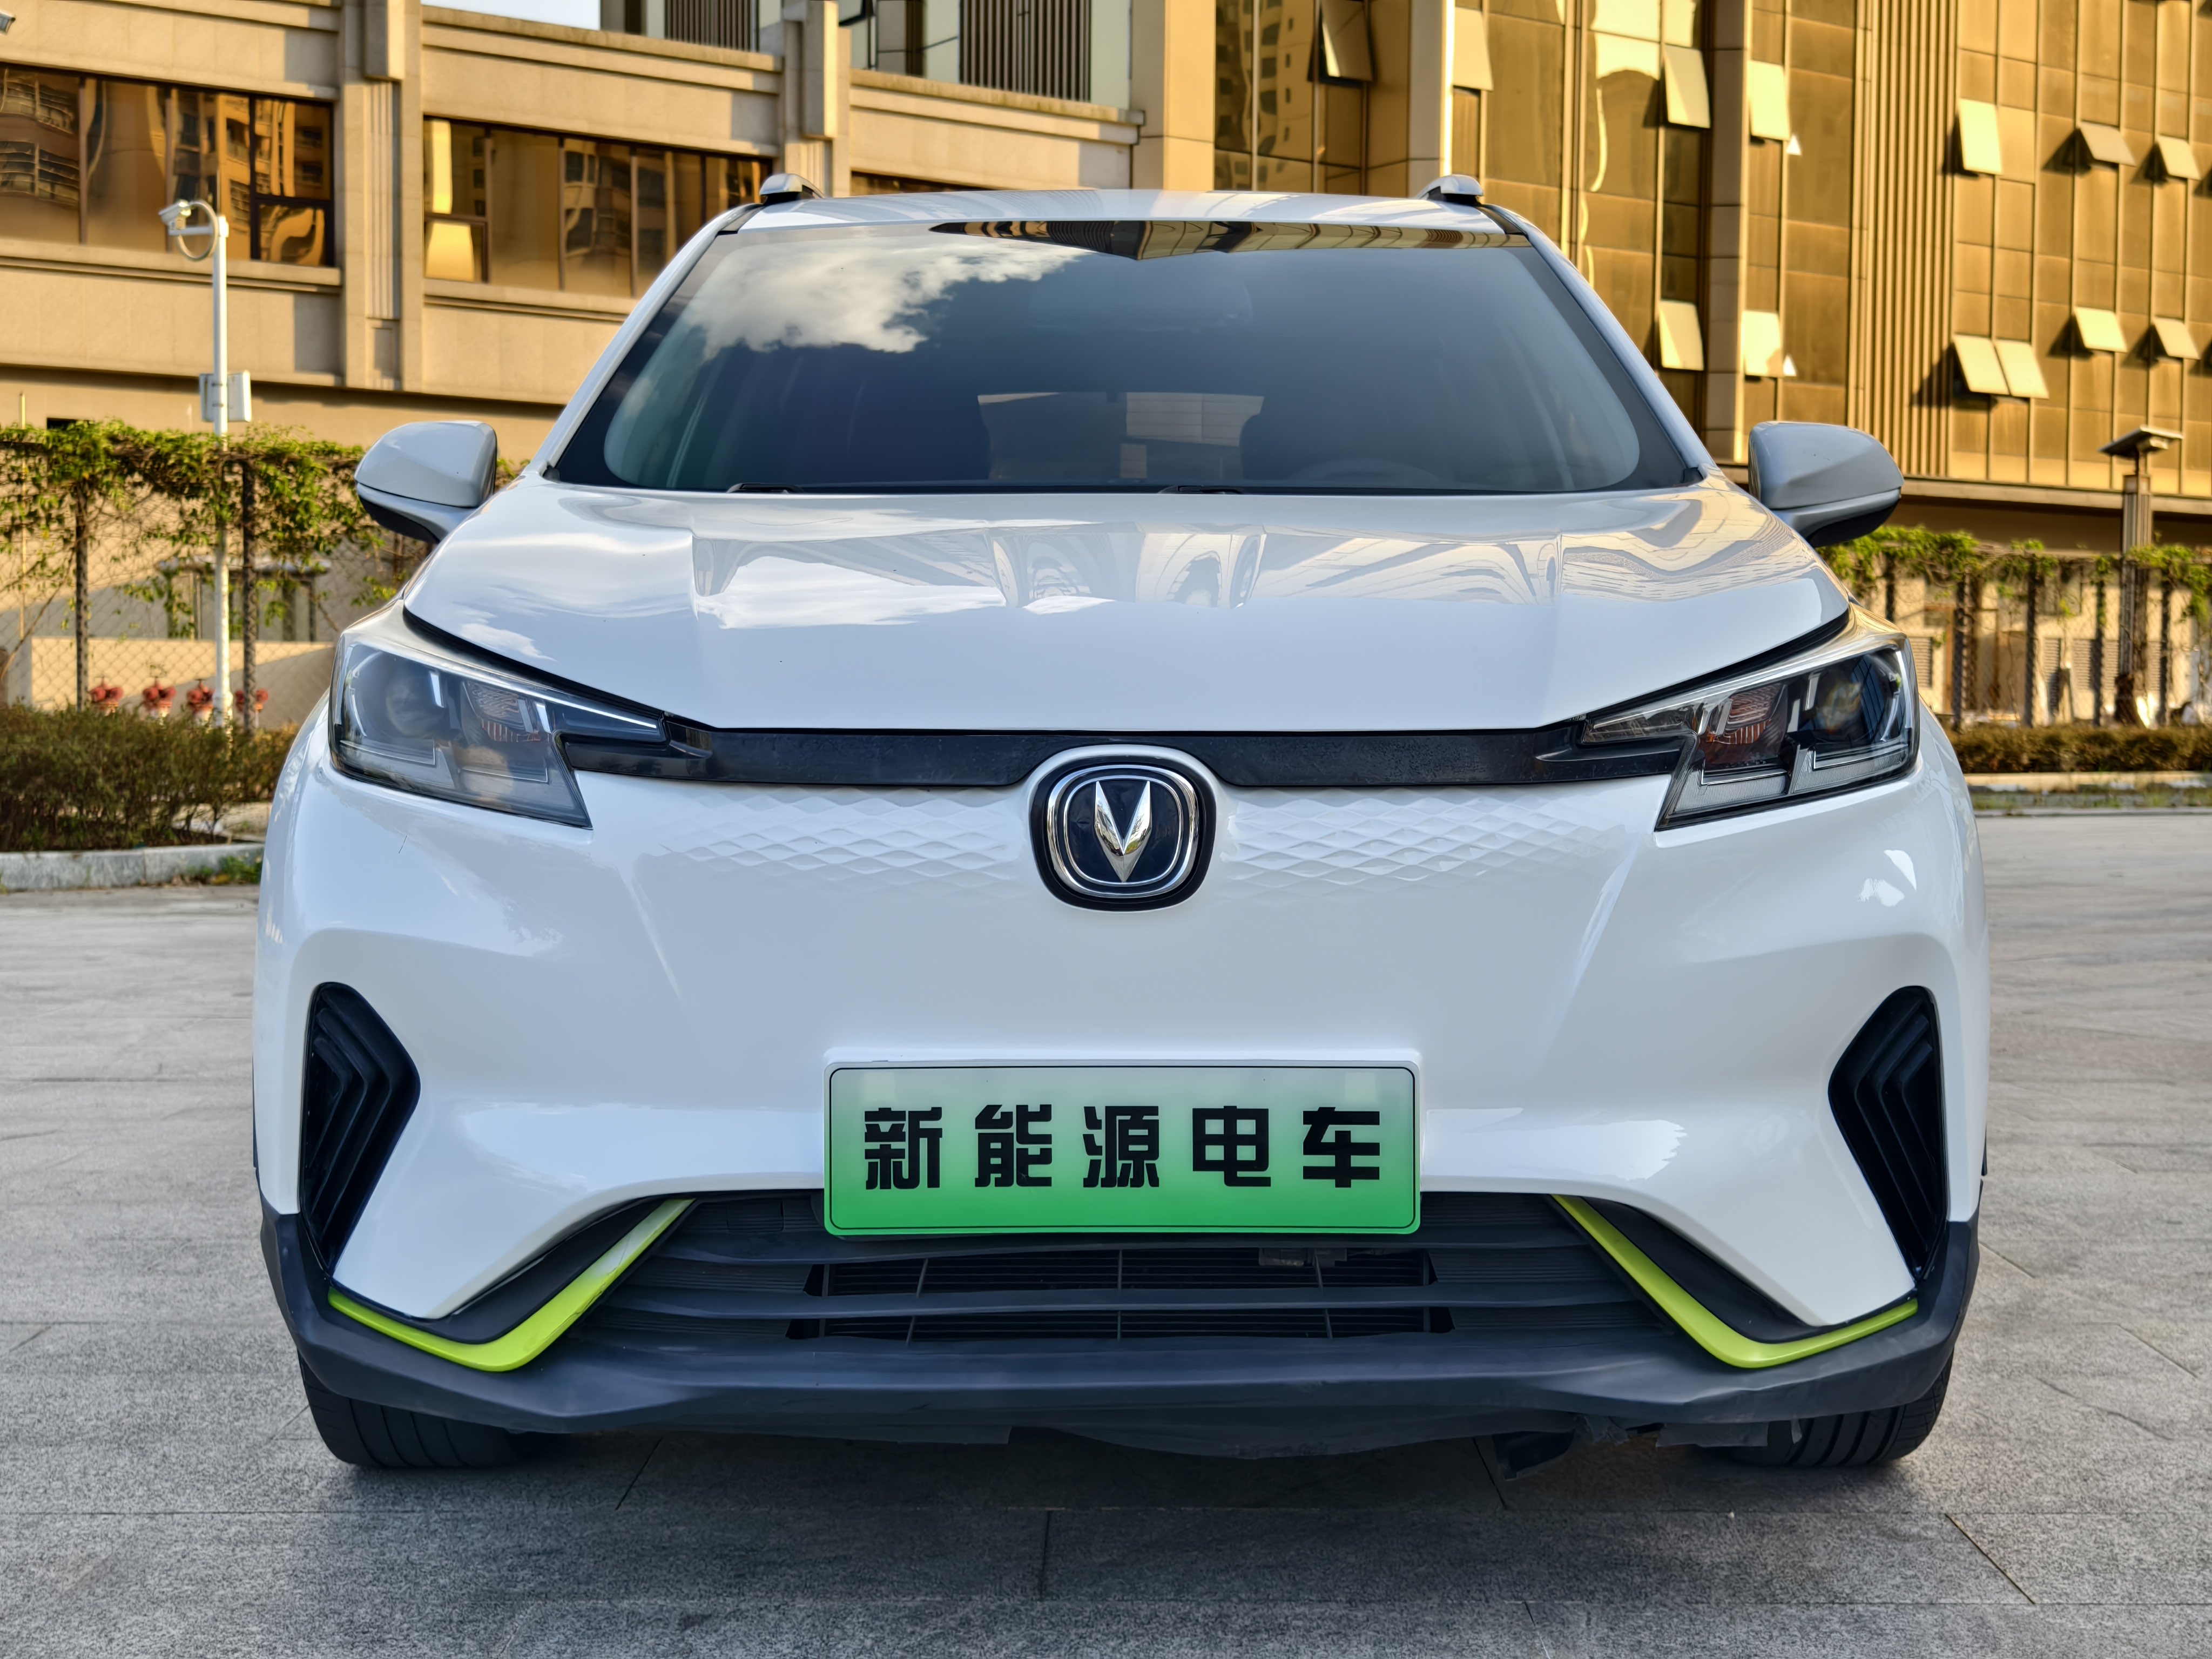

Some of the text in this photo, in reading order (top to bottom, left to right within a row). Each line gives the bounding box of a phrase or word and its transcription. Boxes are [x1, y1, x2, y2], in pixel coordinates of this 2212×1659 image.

[864, 1104, 1381, 1190] 新能源电车
